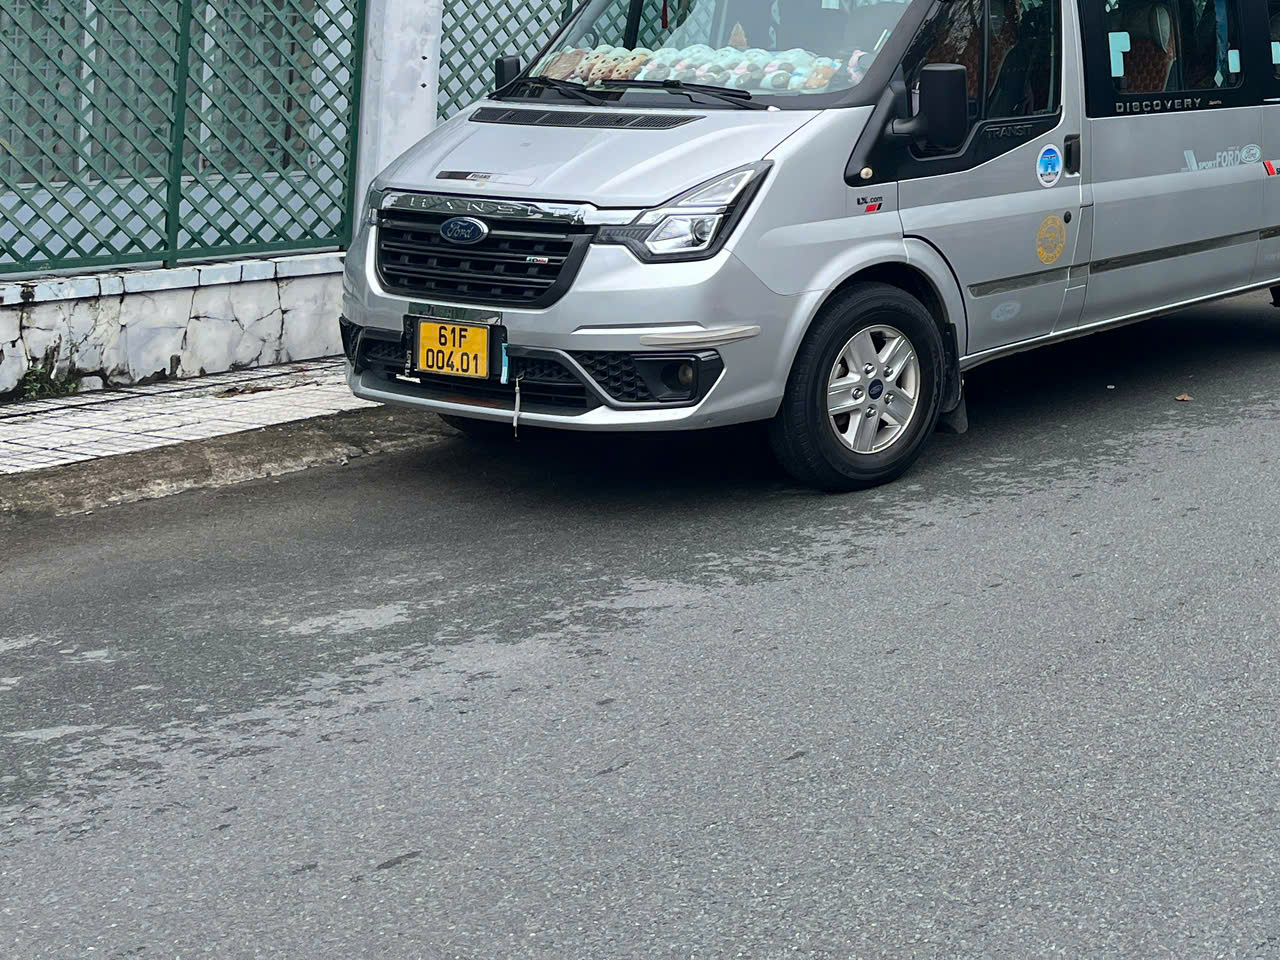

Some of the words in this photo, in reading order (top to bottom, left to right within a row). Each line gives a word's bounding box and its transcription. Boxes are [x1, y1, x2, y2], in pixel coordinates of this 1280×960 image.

[1115, 97, 1201, 113] DISCOVERY
[986, 124, 1033, 137] TRANSIT
[1216, 150, 1241, 167] FORD
[446, 221, 474, 239] Ford
[438, 325, 468, 349] 61F
[425, 348, 479, 374] 004.01
